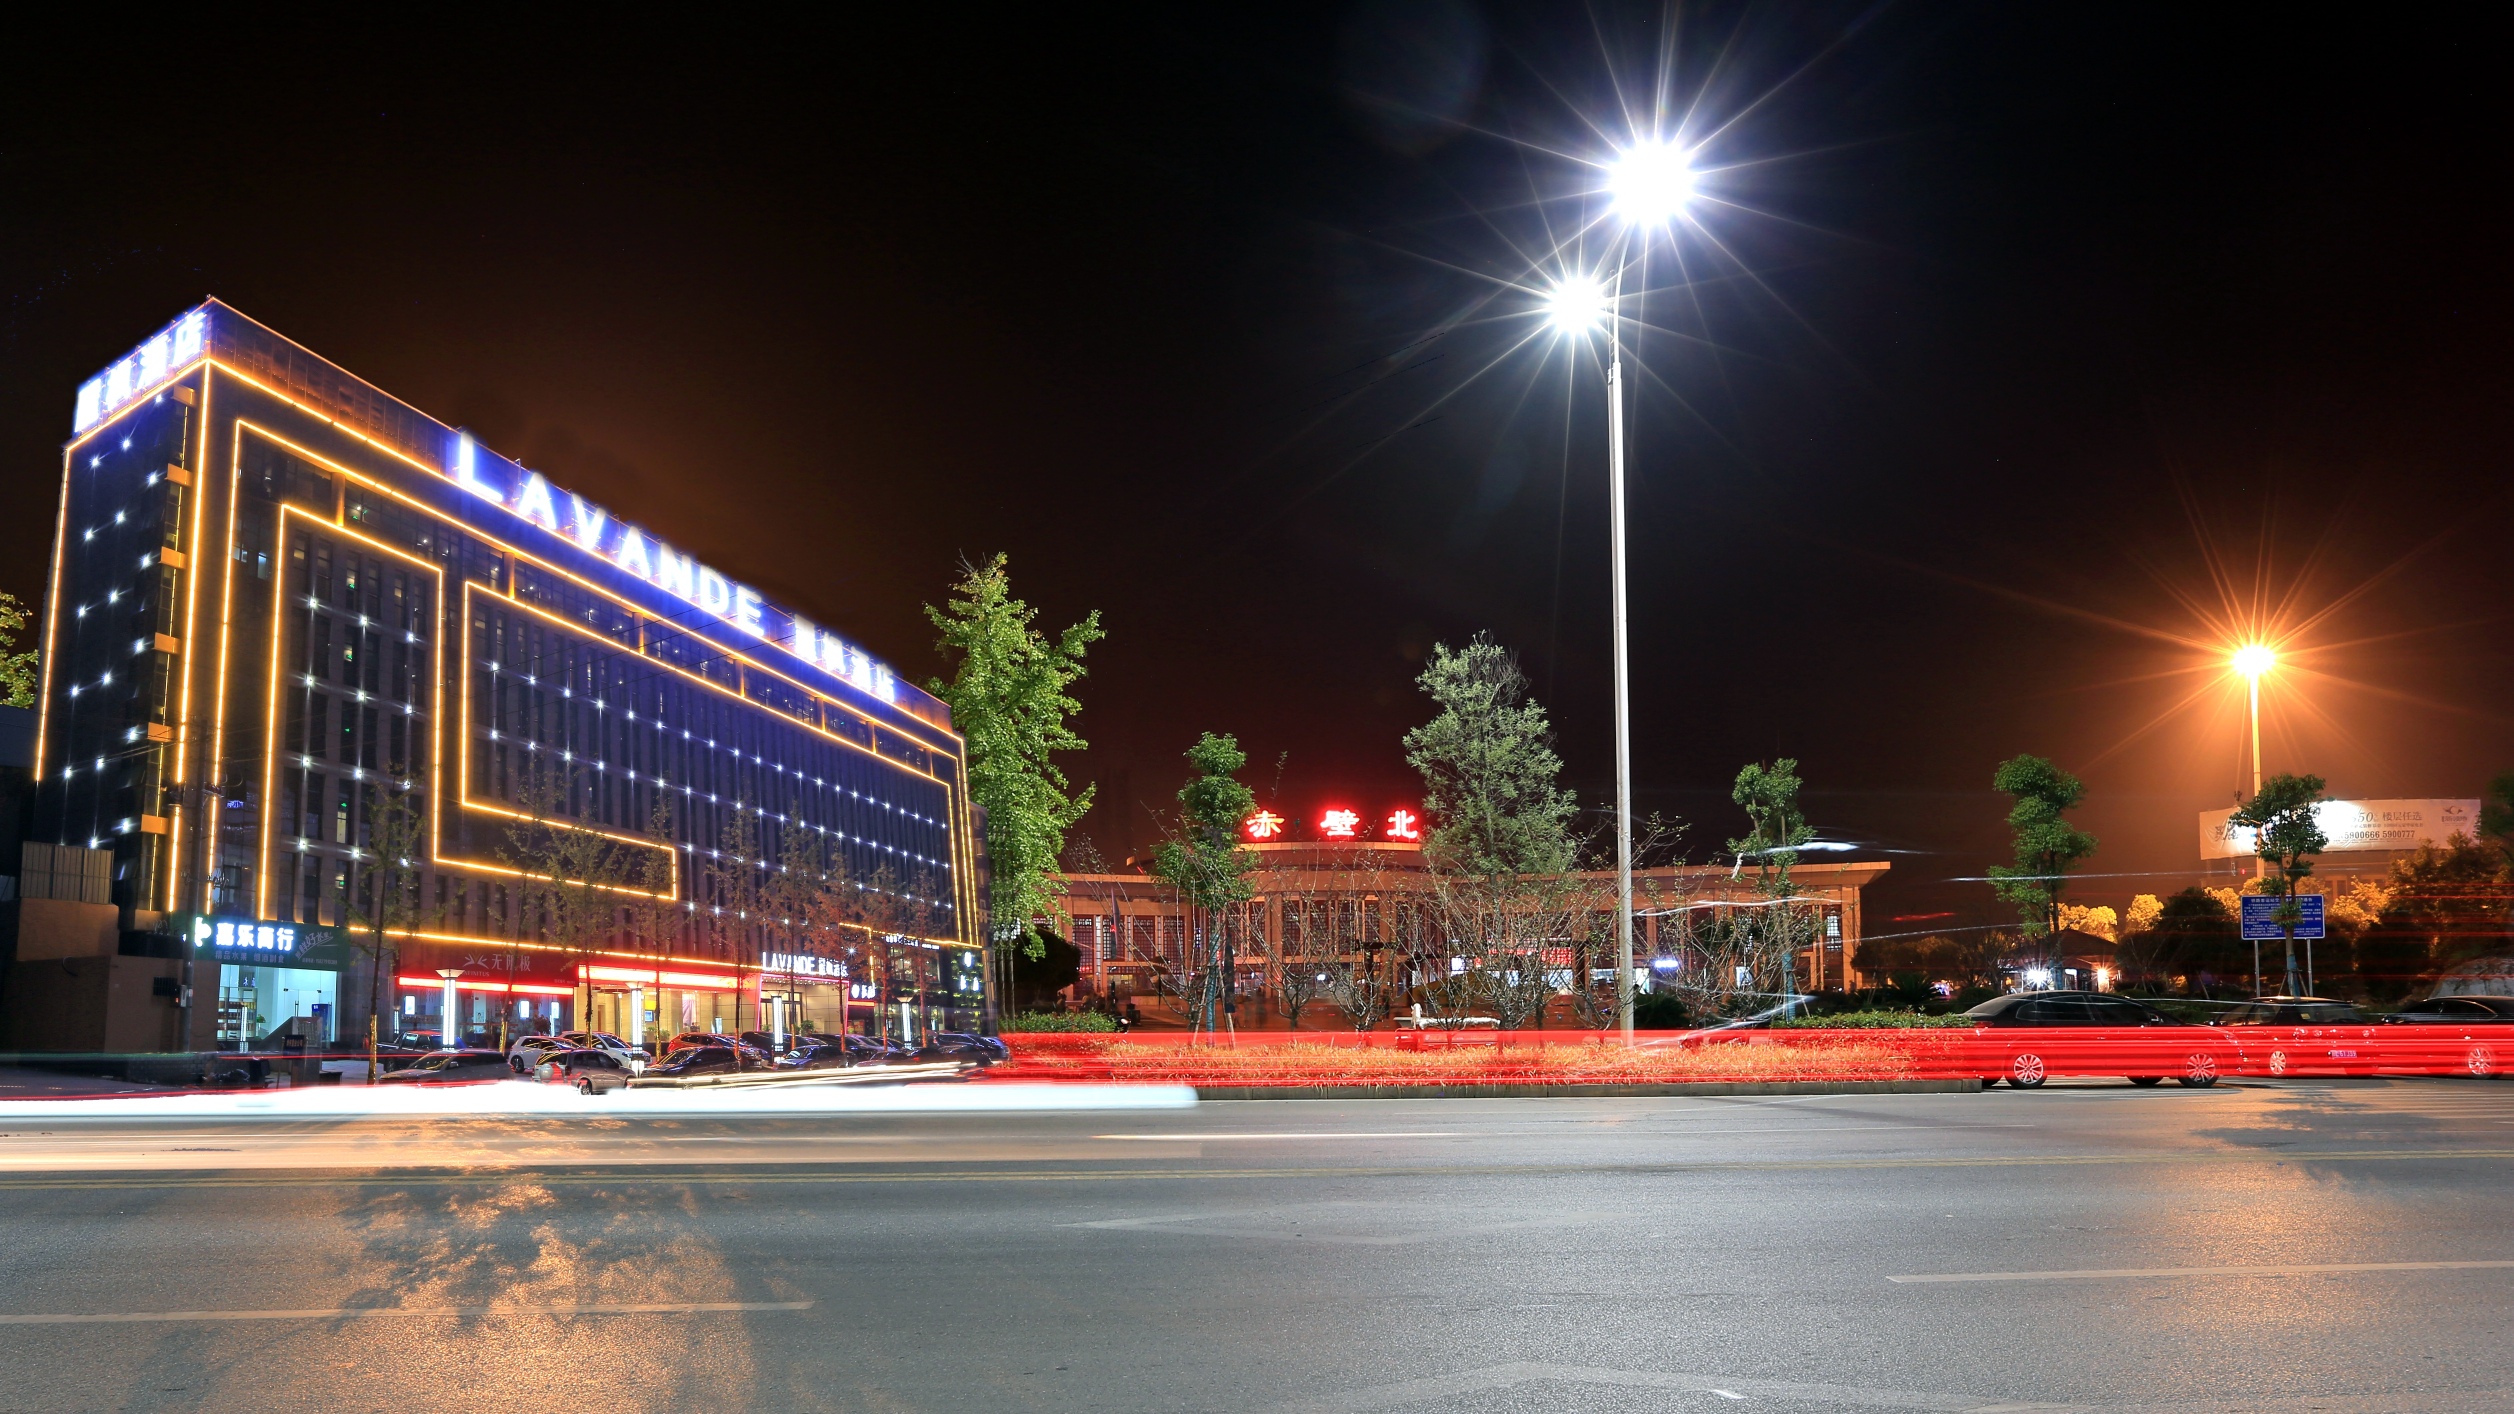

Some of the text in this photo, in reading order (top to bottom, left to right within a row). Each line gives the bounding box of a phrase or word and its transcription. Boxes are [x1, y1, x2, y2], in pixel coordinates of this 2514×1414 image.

[459, 430, 765, 637] LAVANDE
[1245, 808, 1418, 839] 赤壁北
[2344, 829, 2416, 840] 5900666 5900777
